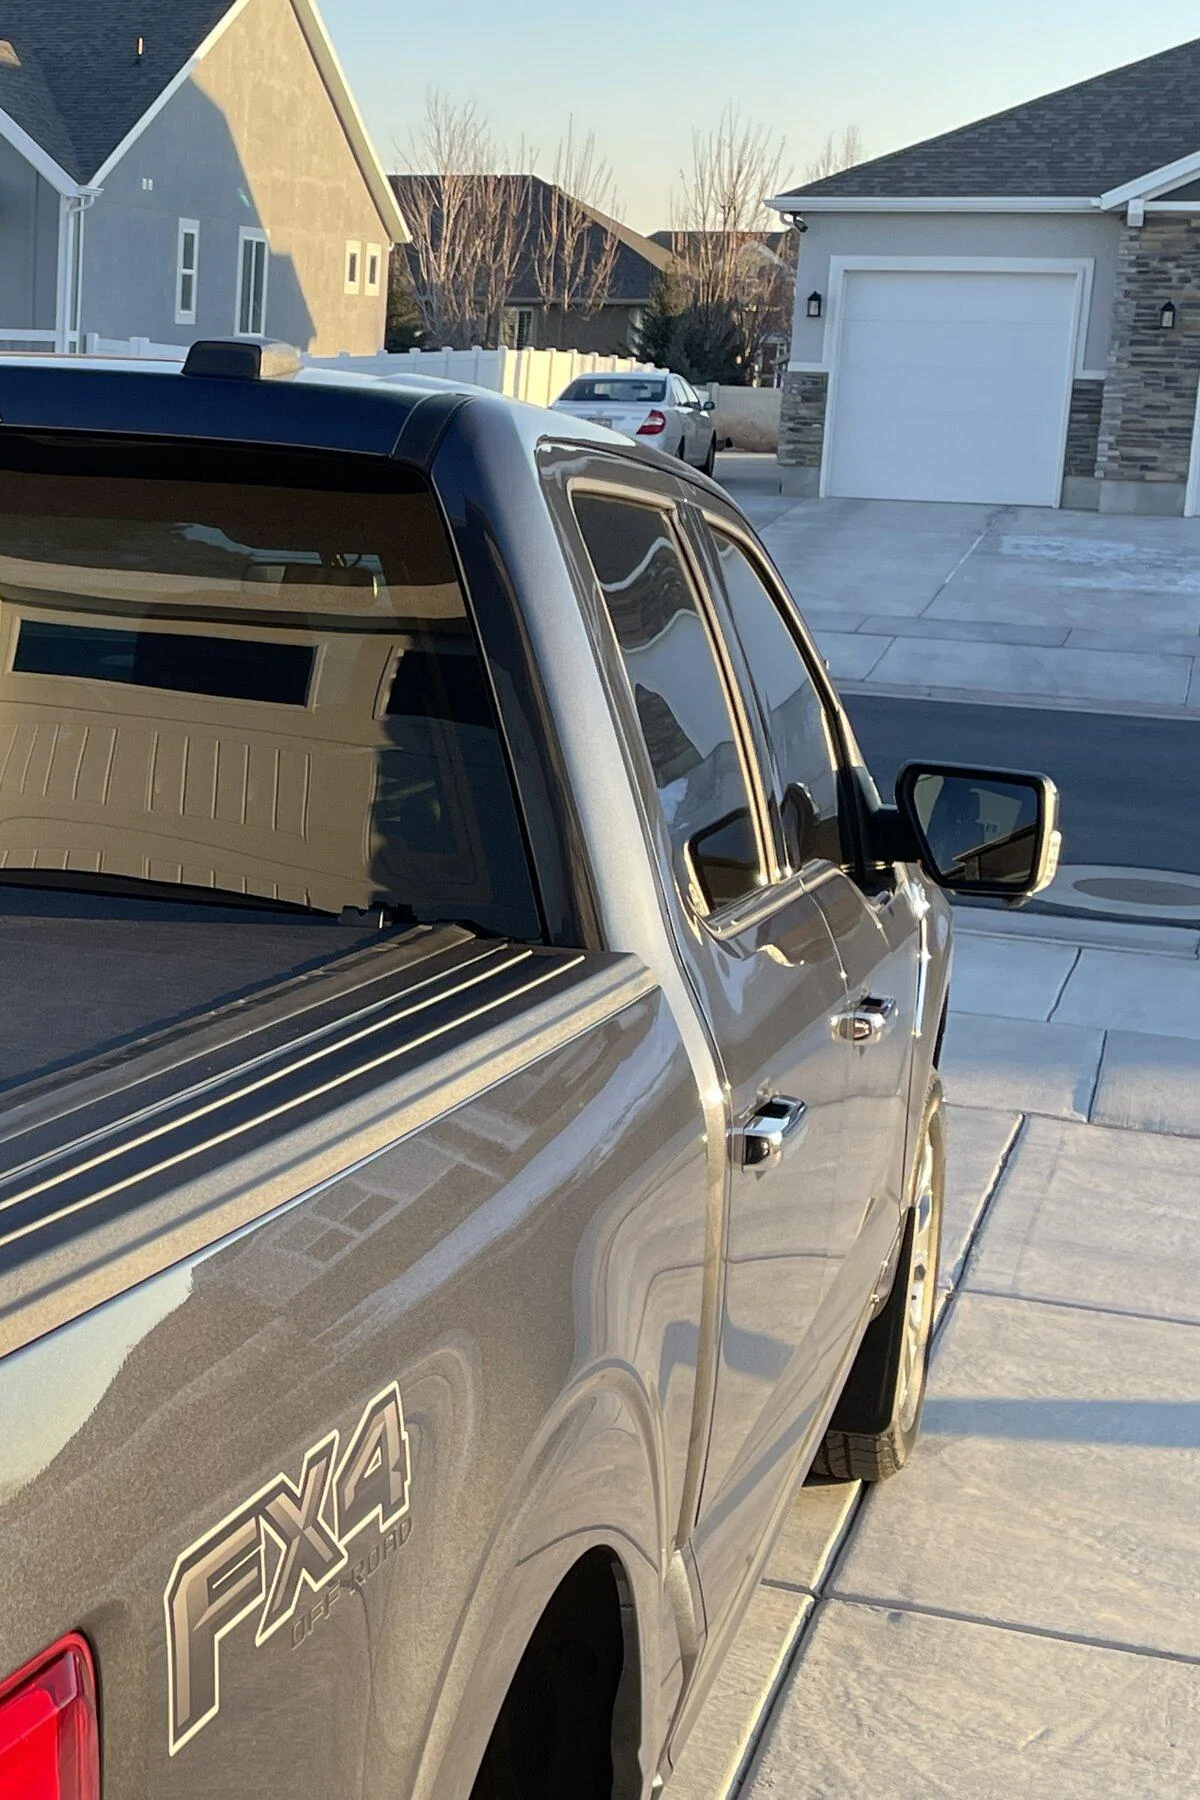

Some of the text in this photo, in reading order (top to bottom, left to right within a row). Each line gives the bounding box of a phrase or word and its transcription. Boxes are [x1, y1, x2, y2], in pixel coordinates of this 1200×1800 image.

[164, 1381, 411, 1757] FX4
[290, 1516, 413, 1651] OFF ROAD
